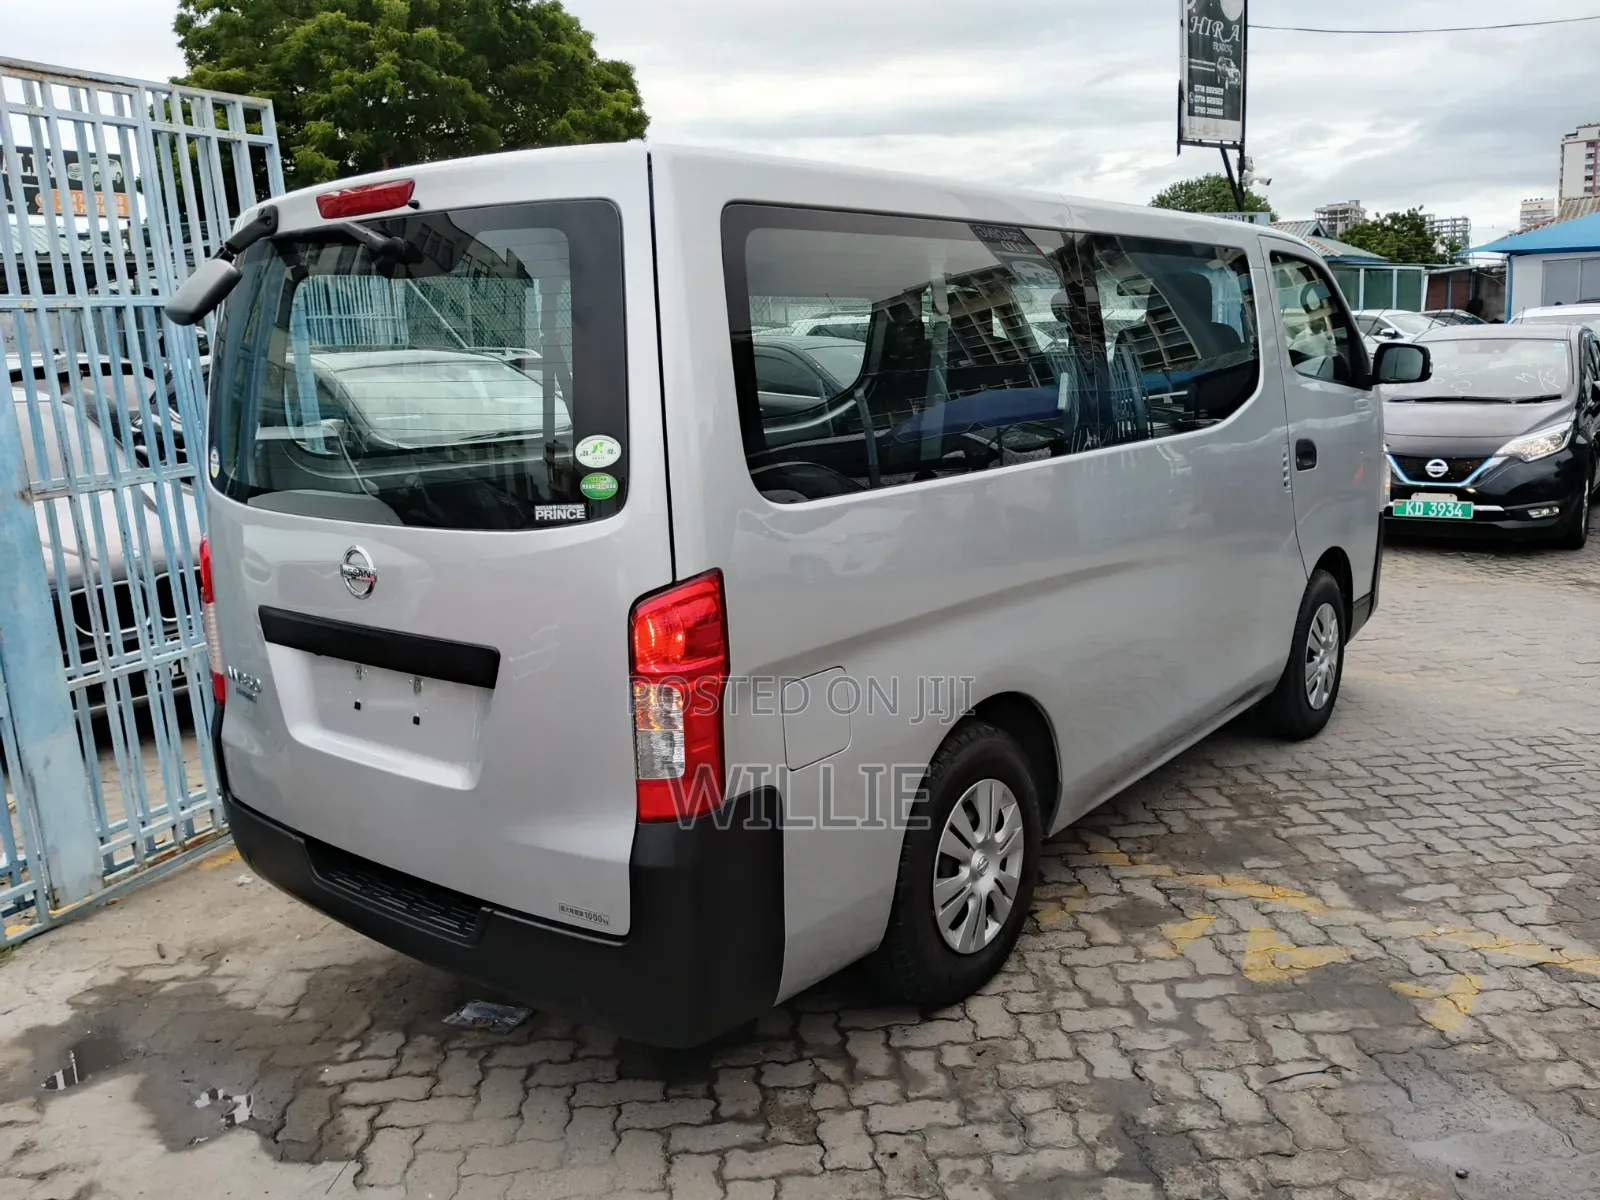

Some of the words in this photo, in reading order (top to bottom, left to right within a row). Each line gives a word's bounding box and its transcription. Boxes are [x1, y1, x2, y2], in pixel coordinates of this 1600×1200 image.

[1189, 16, 1240, 43] HIRA
[535, 509, 586, 520] PRINCE
[1405, 501, 1424, 516] KD
[1428, 502, 1463, 518] 3934
